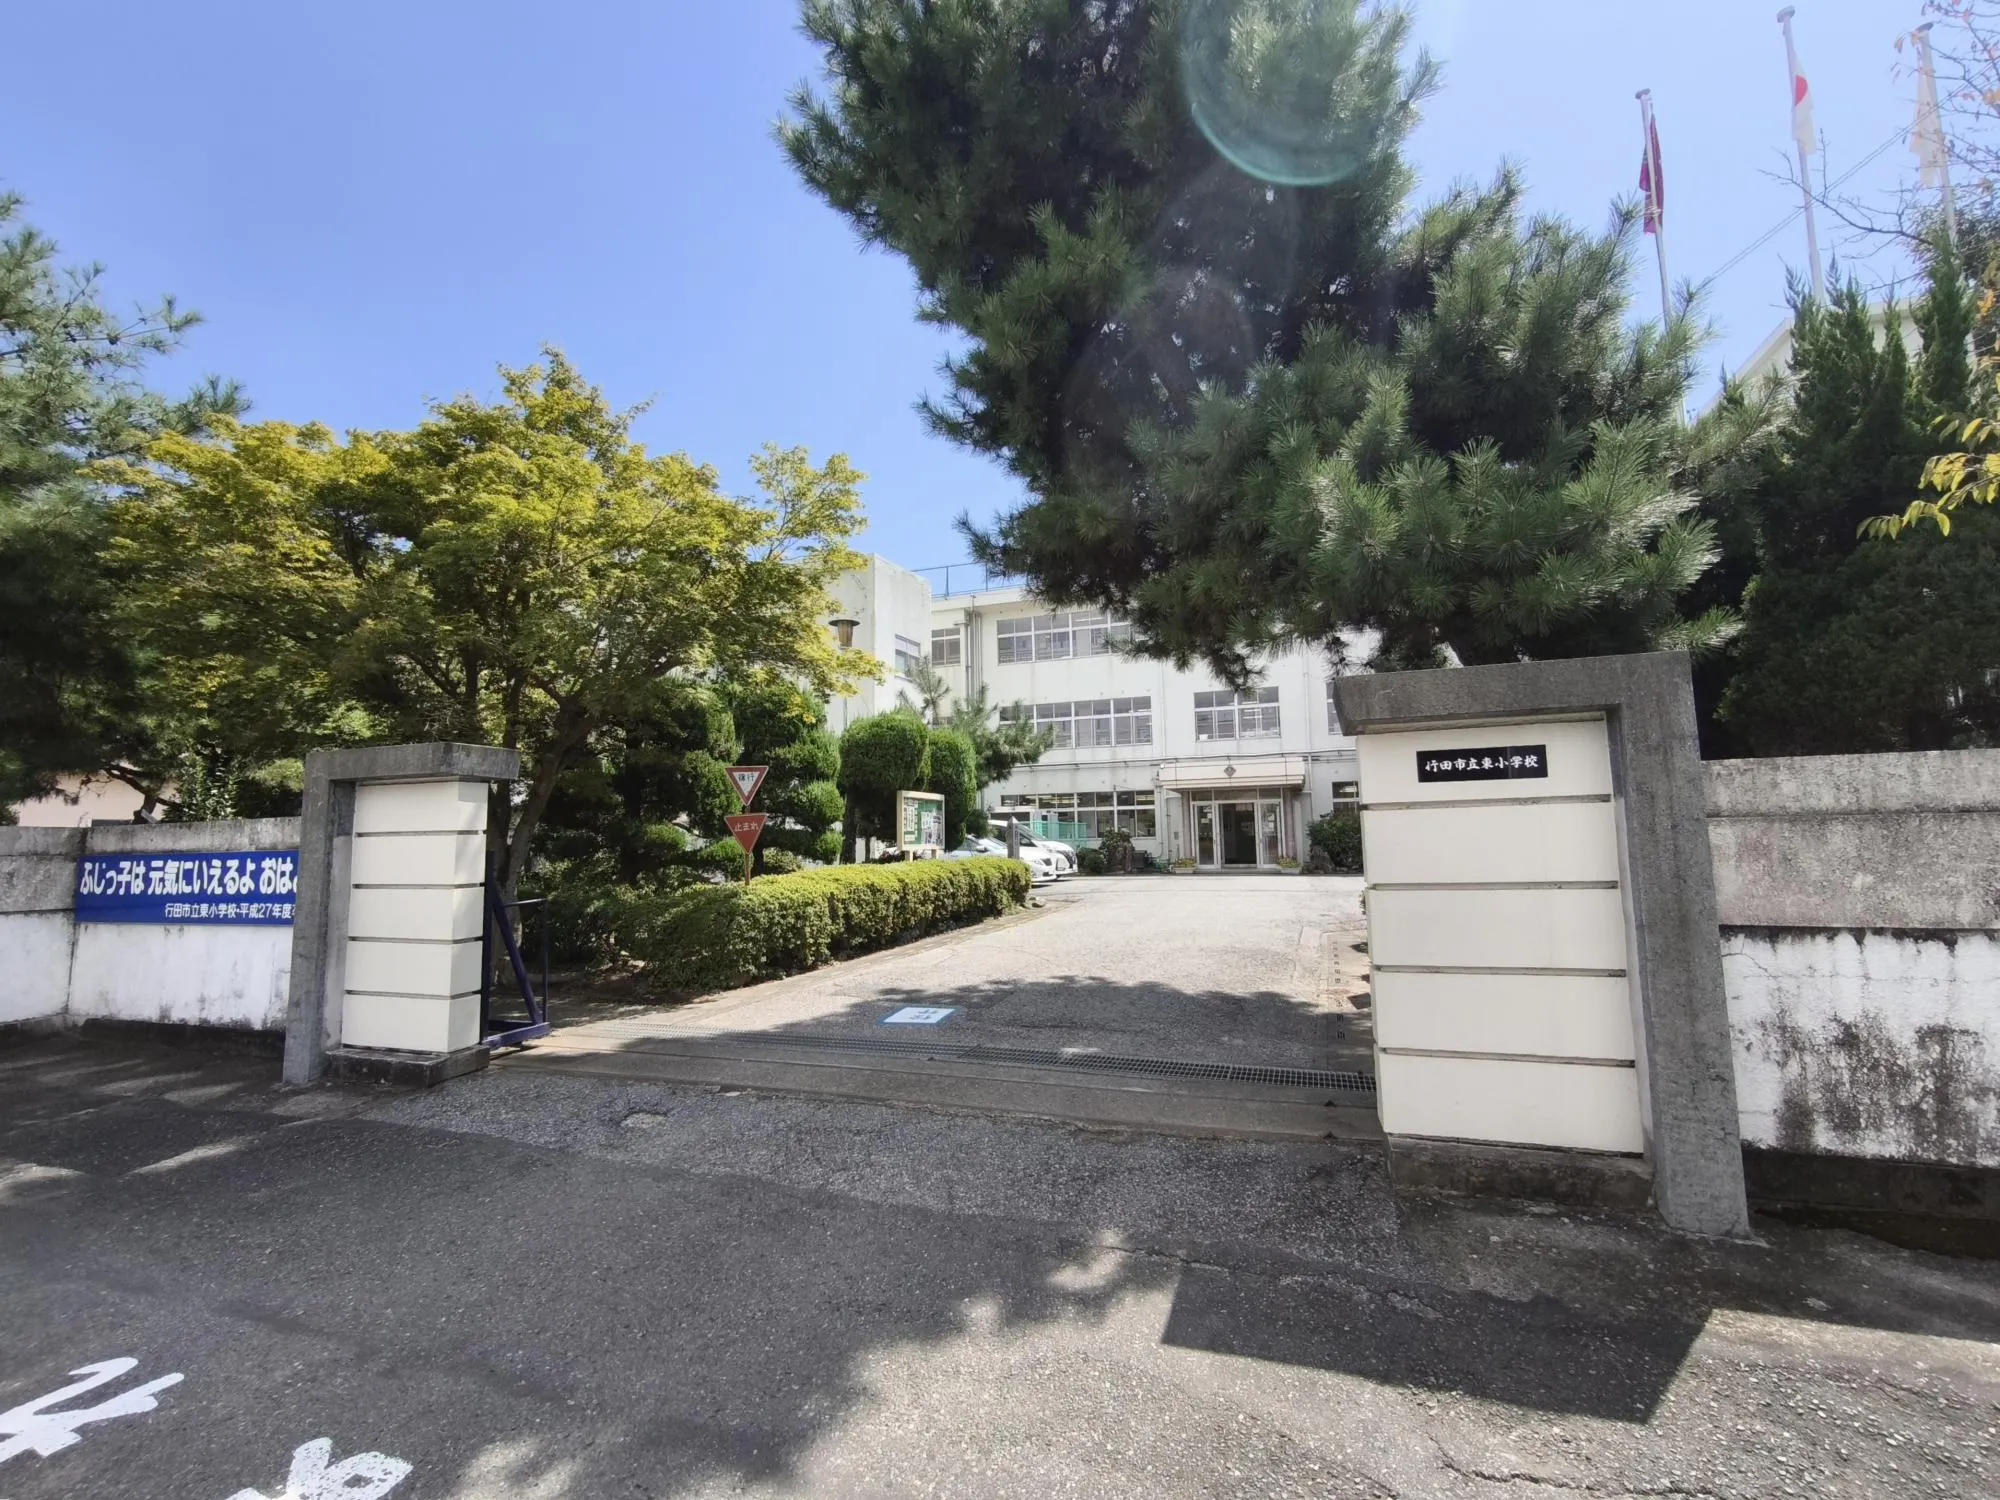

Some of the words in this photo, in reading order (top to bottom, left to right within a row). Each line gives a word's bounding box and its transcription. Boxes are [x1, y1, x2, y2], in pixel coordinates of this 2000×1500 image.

[1425, 754, 1539, 772] 行田市立東小学校
[734, 822, 759, 832] 止まれ
[79, 860, 146, 895] ふじっ子は
[148, 858, 256, 895] 元気にいえるよ
[259, 856, 297, 894] おは
